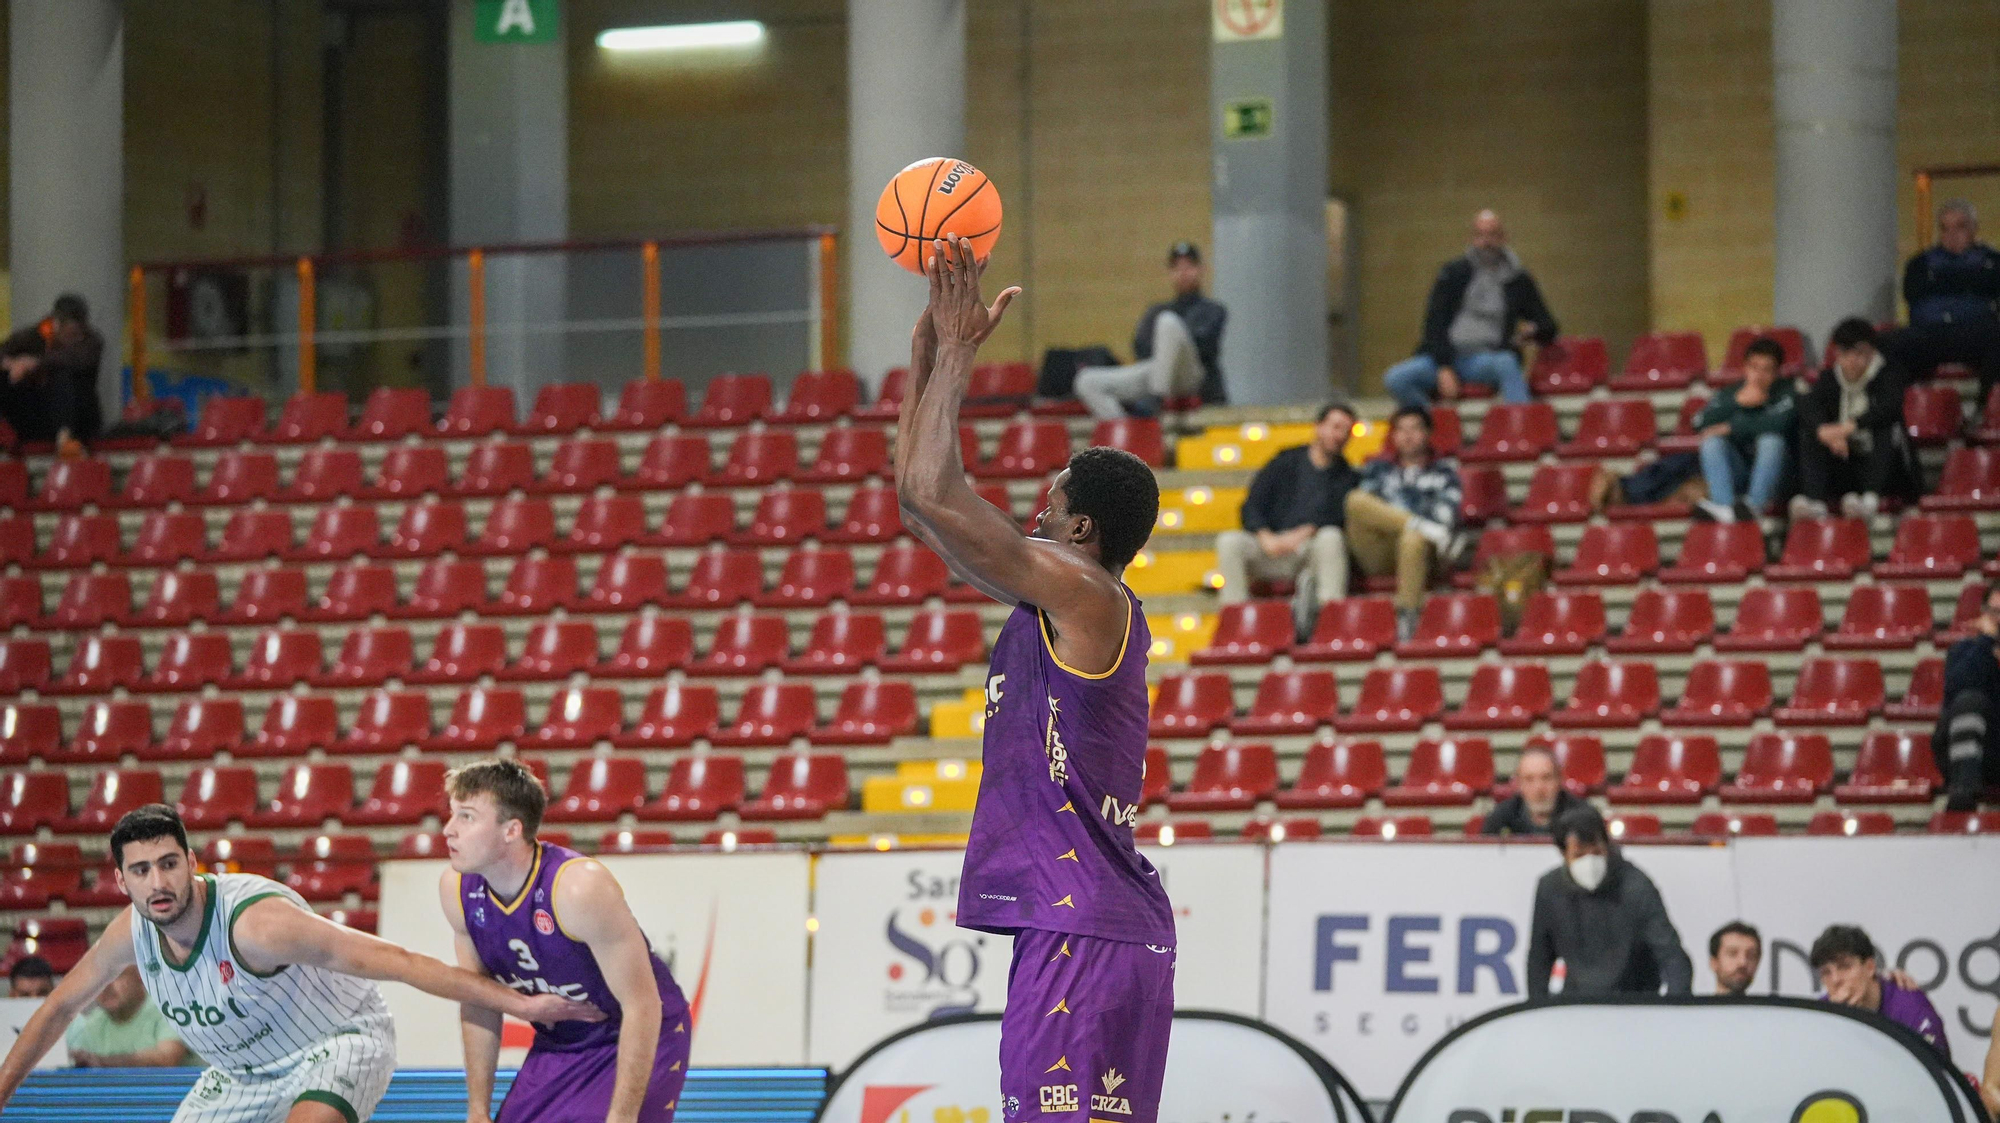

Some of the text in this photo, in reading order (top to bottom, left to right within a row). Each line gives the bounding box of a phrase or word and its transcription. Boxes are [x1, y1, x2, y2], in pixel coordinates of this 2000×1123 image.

[496, 0, 536, 35] A
[507, 937, 540, 972] 3
[225, 1022, 274, 1053] Cajasol
[1039, 1084, 1079, 1106] CBC
[1090, 1094, 1133, 1116] CRZA
[1040, 1104, 1079, 1113] VALLADOLID
